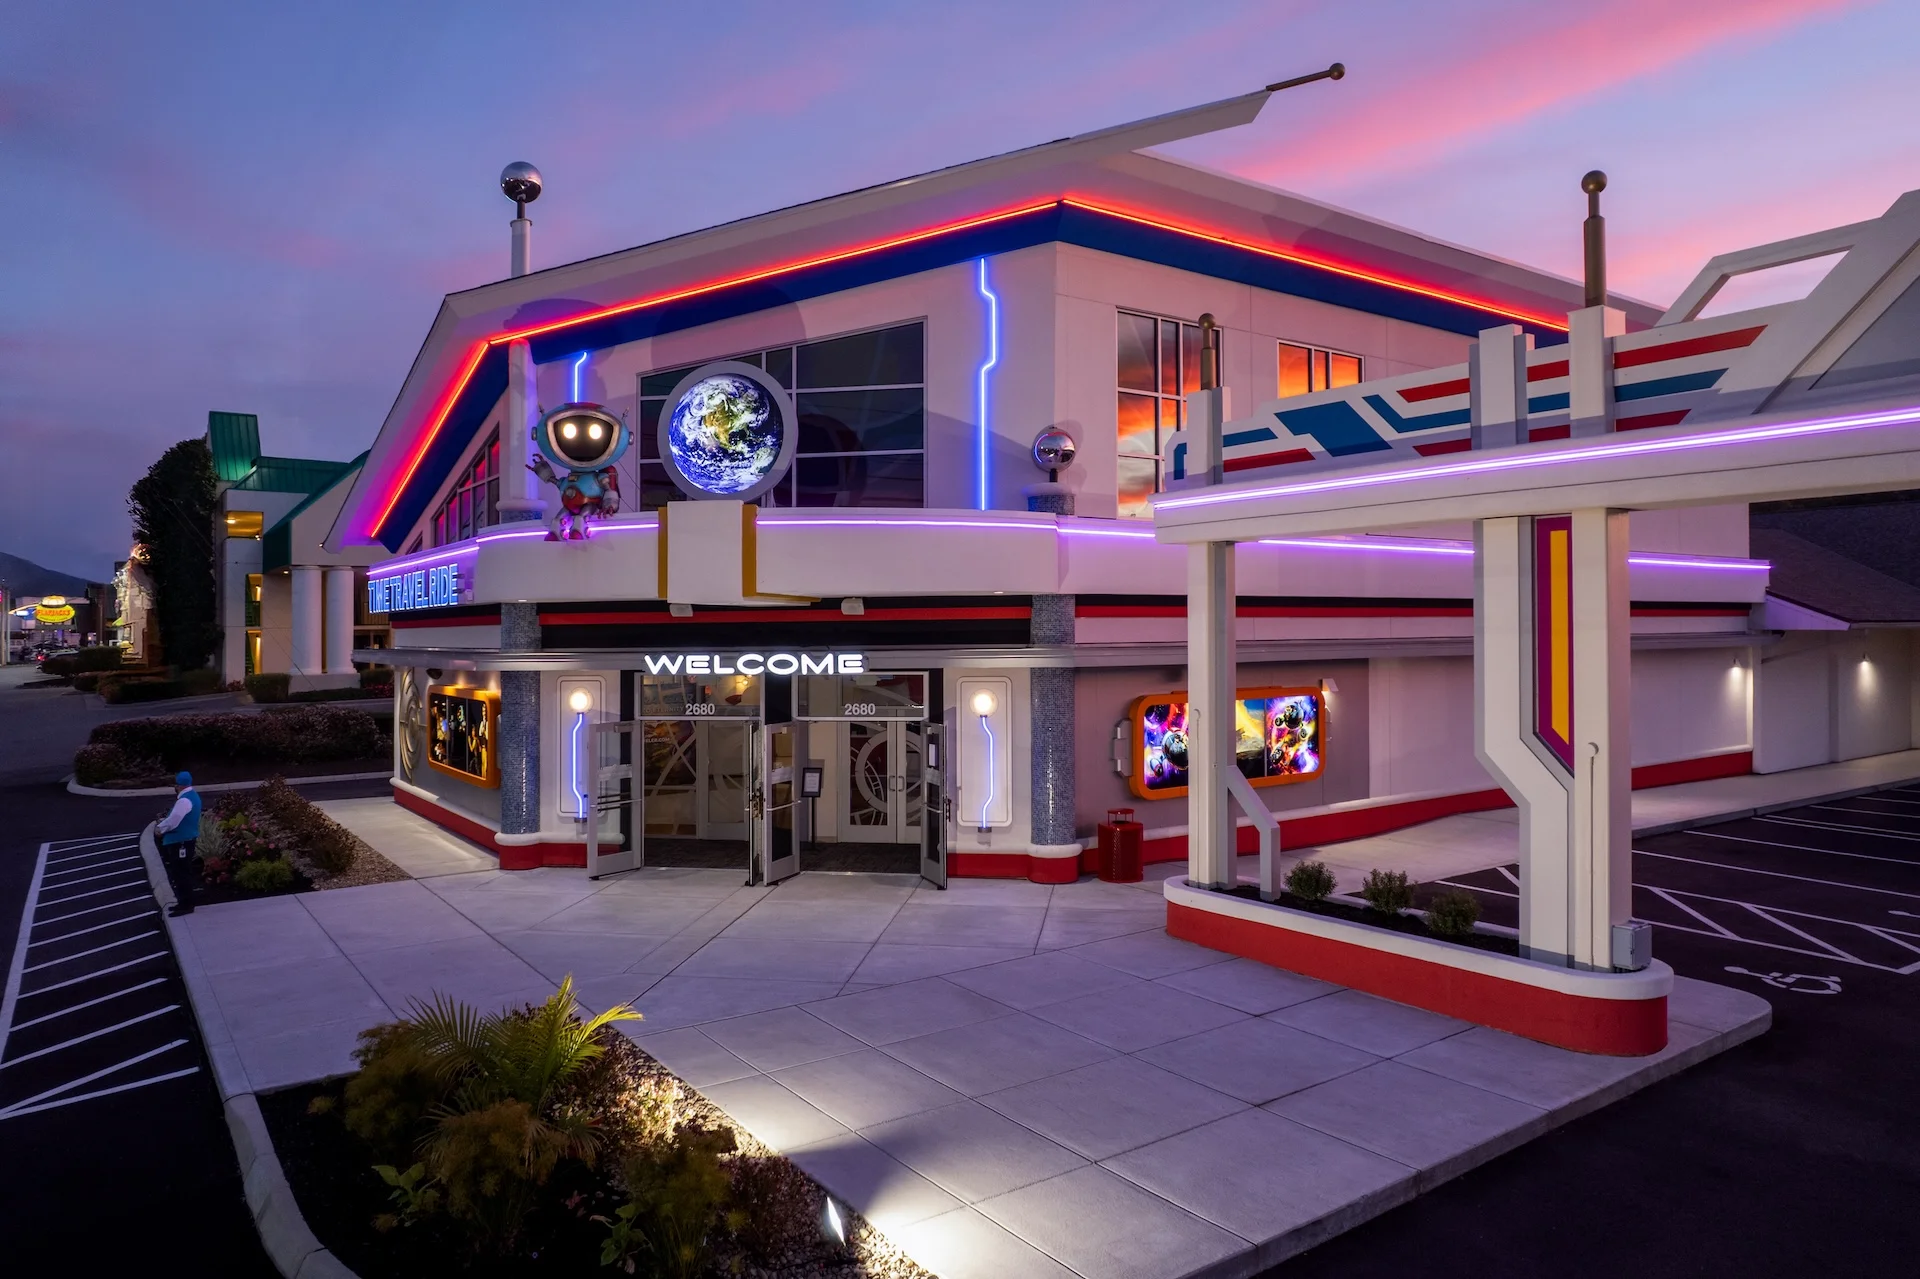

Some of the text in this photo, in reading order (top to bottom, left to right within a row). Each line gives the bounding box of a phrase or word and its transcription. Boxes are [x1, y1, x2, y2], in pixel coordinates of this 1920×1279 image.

[368, 563, 458, 613] TIME TRAVEL RIDE
[644, 653, 864, 675] WELCOME
[685, 703, 715, 716] 2680
[844, 703, 876, 716] 2680
